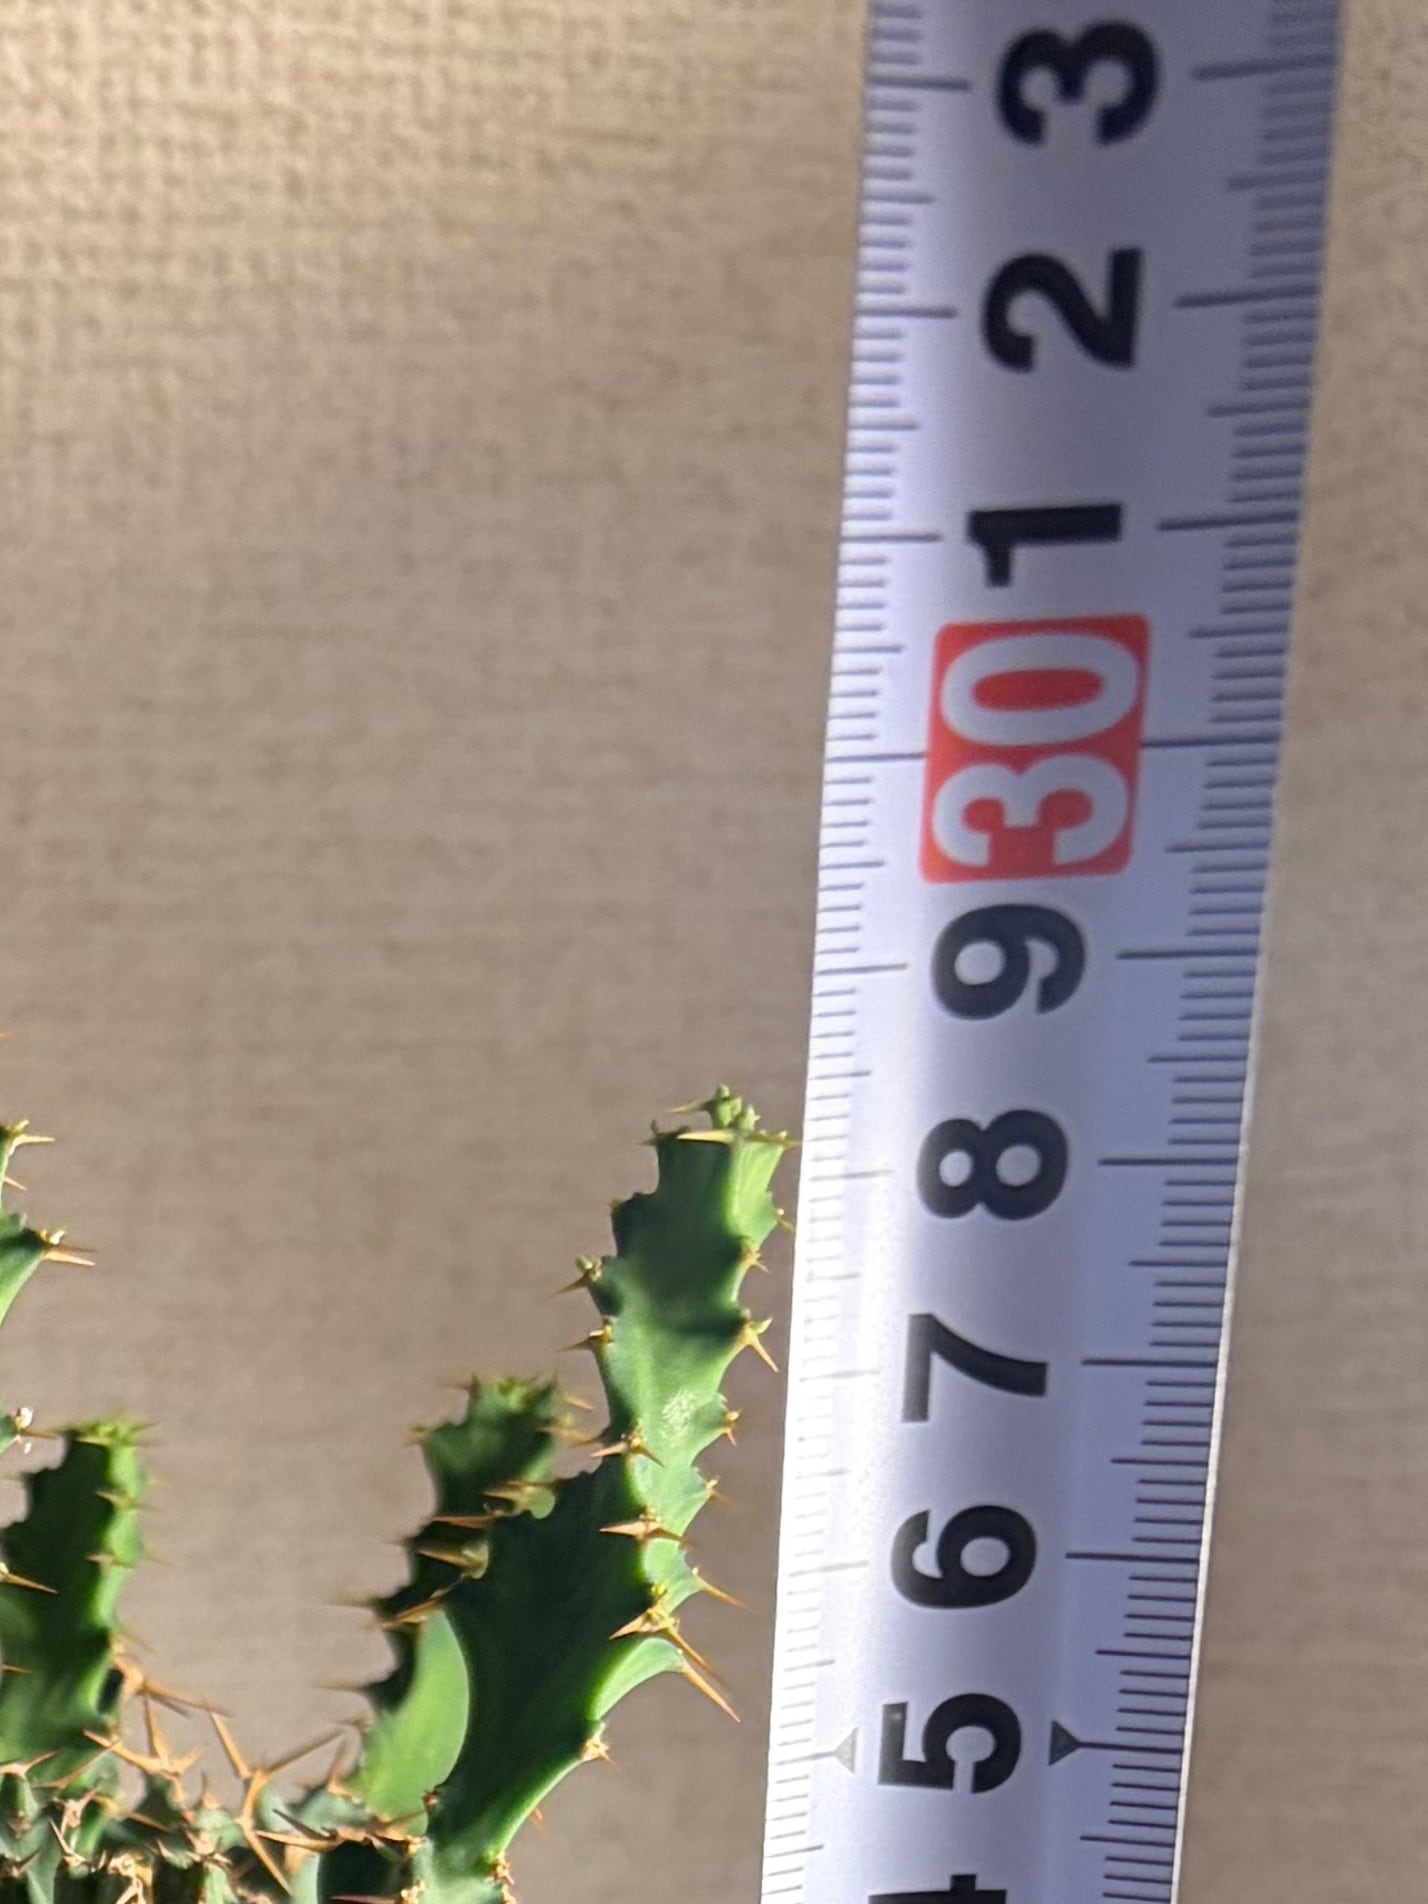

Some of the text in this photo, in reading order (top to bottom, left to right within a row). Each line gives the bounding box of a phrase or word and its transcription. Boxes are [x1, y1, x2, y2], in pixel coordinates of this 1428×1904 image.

[995, 21, 1161, 147] 3
[980, 249, 1142, 371] 2
[967, 502, 1122, 587] 1
[931, 634, 1140, 867] 30
[931, 903, 1087, 1020] 9
[916, 1109, 1068, 1220] 8
[901, 1313, 1049, 1423] 7
[890, 1504, 1037, 1610] 6
[877, 1693, 1021, 1794] 5
